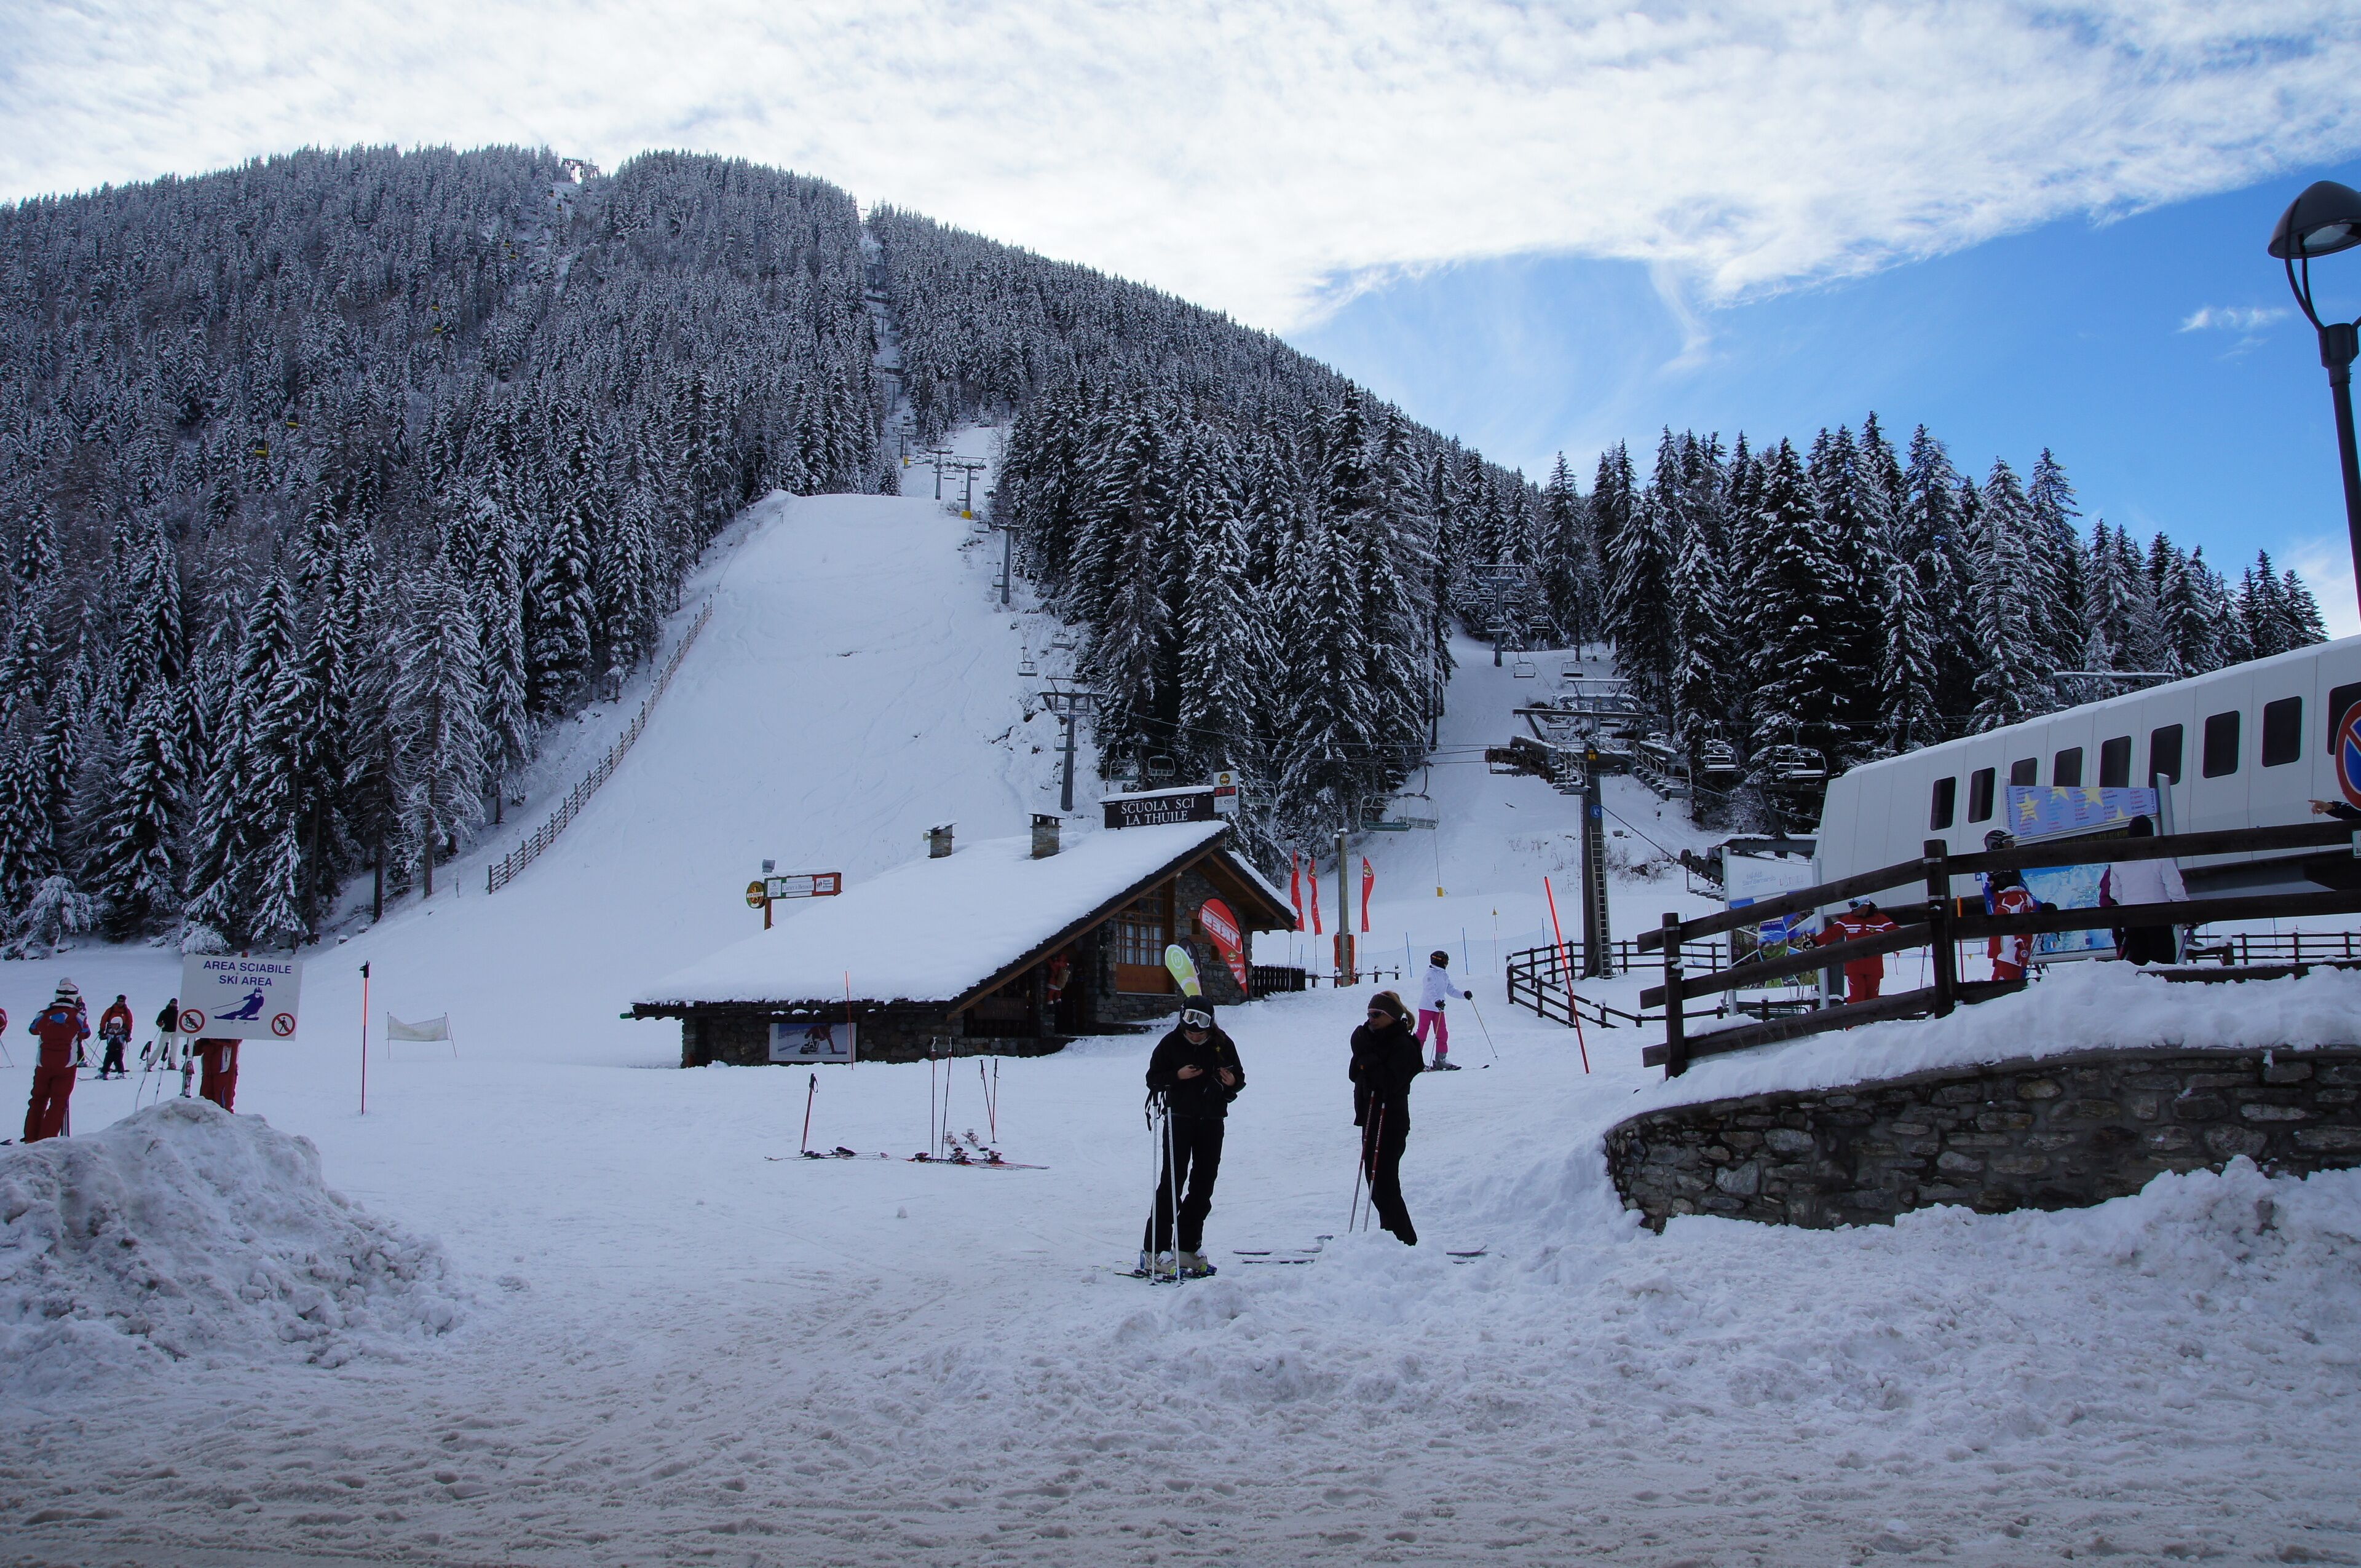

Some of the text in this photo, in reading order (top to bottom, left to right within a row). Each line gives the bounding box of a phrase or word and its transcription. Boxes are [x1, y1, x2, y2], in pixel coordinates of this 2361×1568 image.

[1121, 798, 1195, 814] SCUOLA SCI
[1126, 810, 1188, 826] LA THUILE
[204, 960, 292, 974] AREA SCIABILE
[219, 975, 272, 987] SKI AREA
